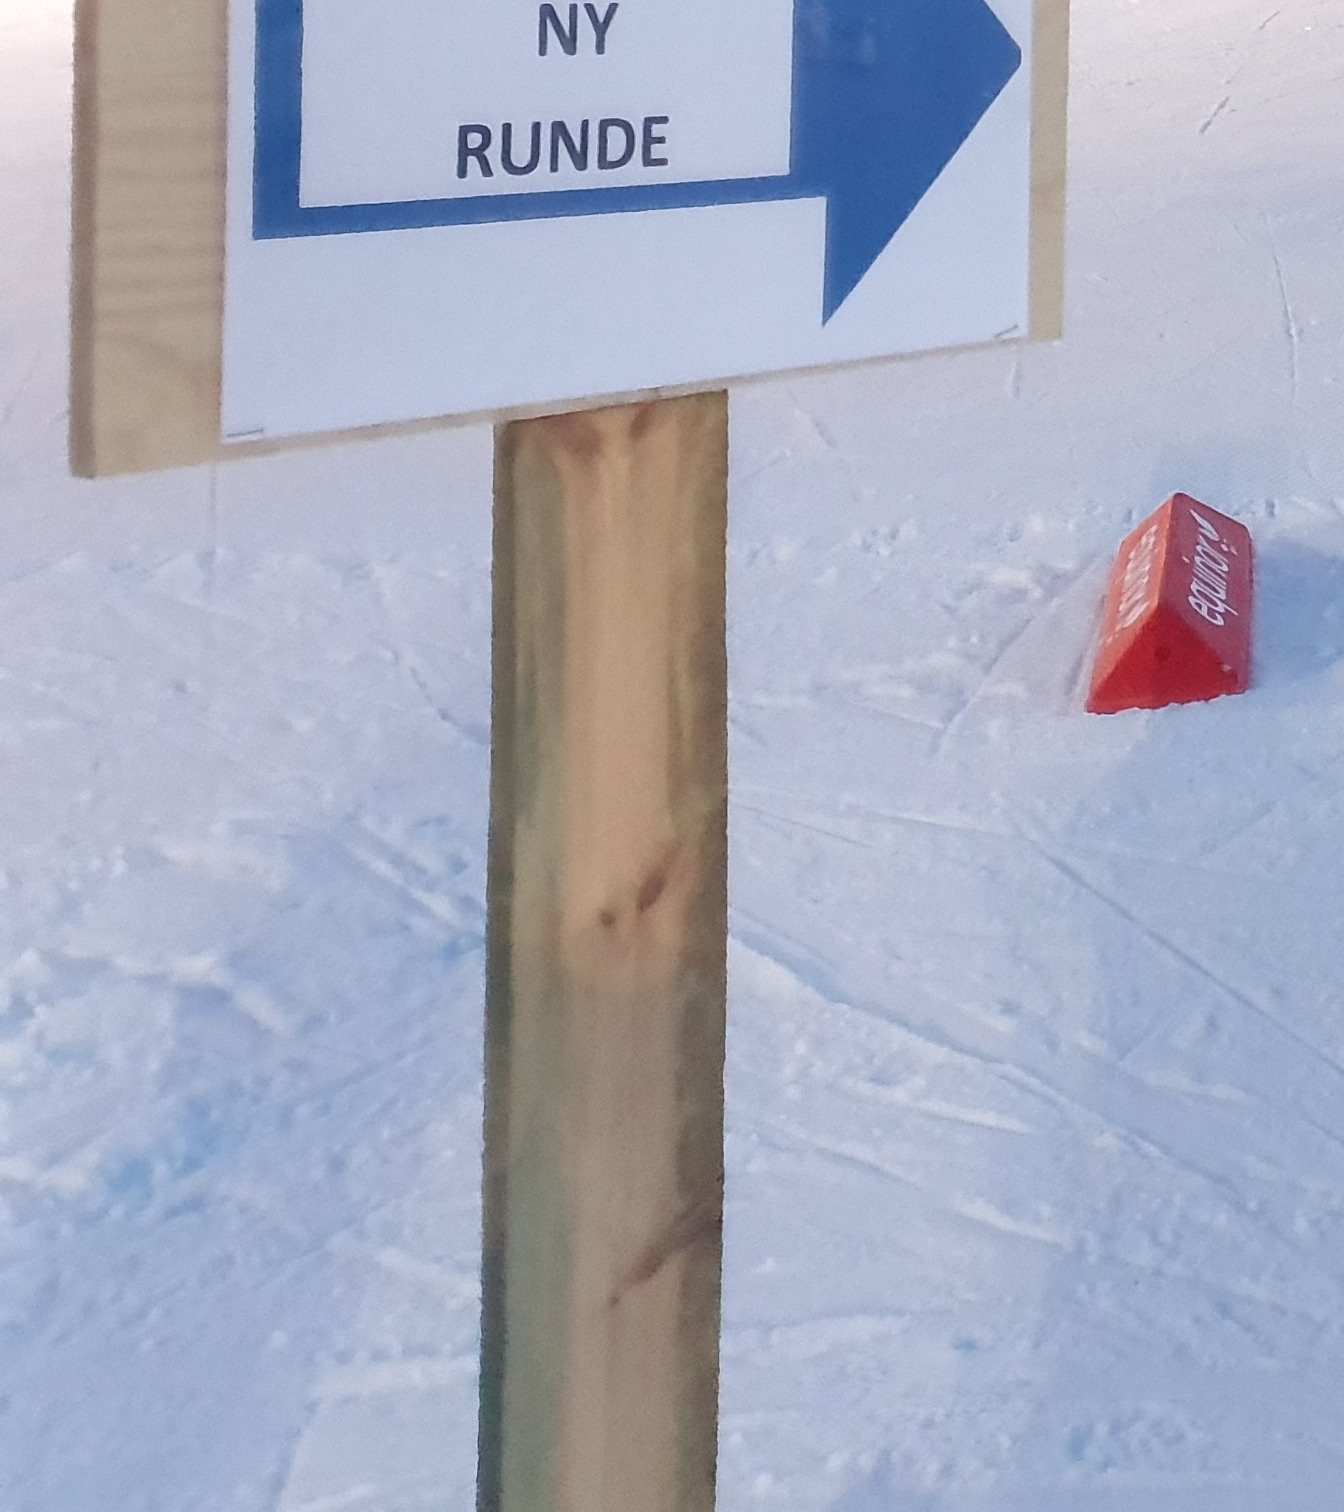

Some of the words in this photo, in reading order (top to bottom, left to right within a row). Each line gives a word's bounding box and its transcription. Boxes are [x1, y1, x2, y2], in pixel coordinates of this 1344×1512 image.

[538, 2, 619, 57] NY
[456, 115, 670, 179] RUNDE
[1182, 534, 1239, 626] equinor
